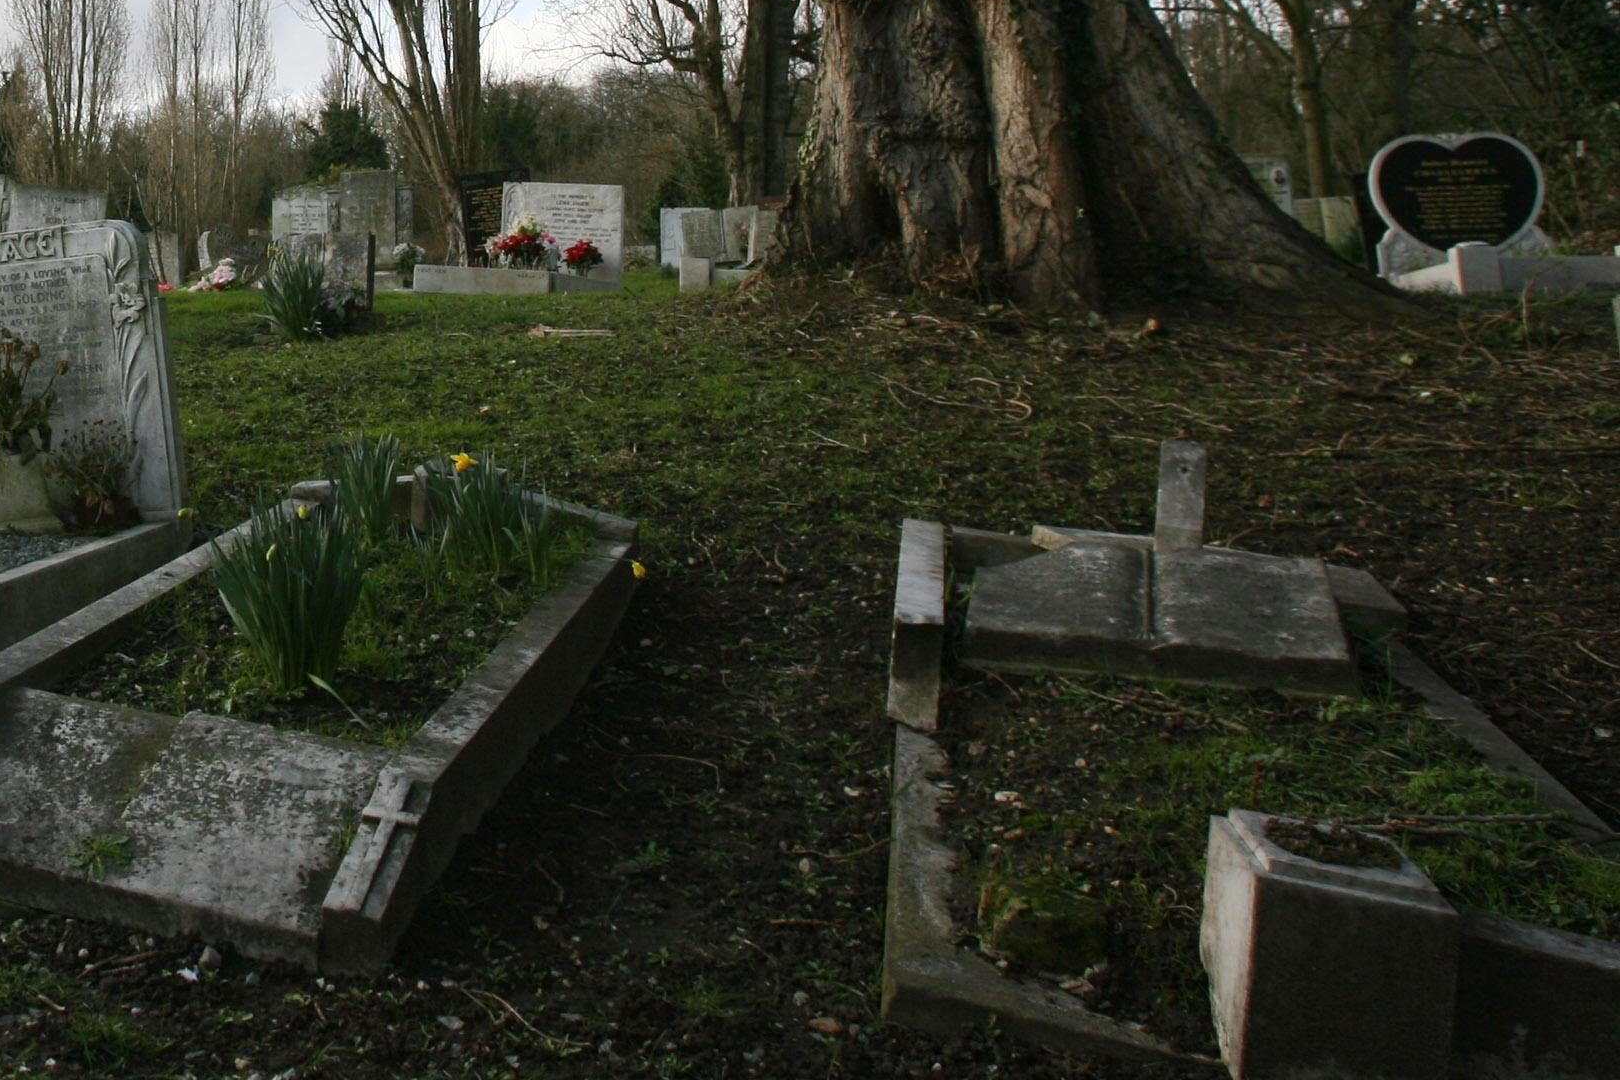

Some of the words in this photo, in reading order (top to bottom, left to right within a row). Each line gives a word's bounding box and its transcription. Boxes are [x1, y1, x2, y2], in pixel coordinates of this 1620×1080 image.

[10, 273, 21, 281] OF
[24, 271, 30, 280] A
[33, 266, 67, 279] LOVING
[30, 278, 69, 290] MOTHER
[13, 290, 66, 305] GOLDING
